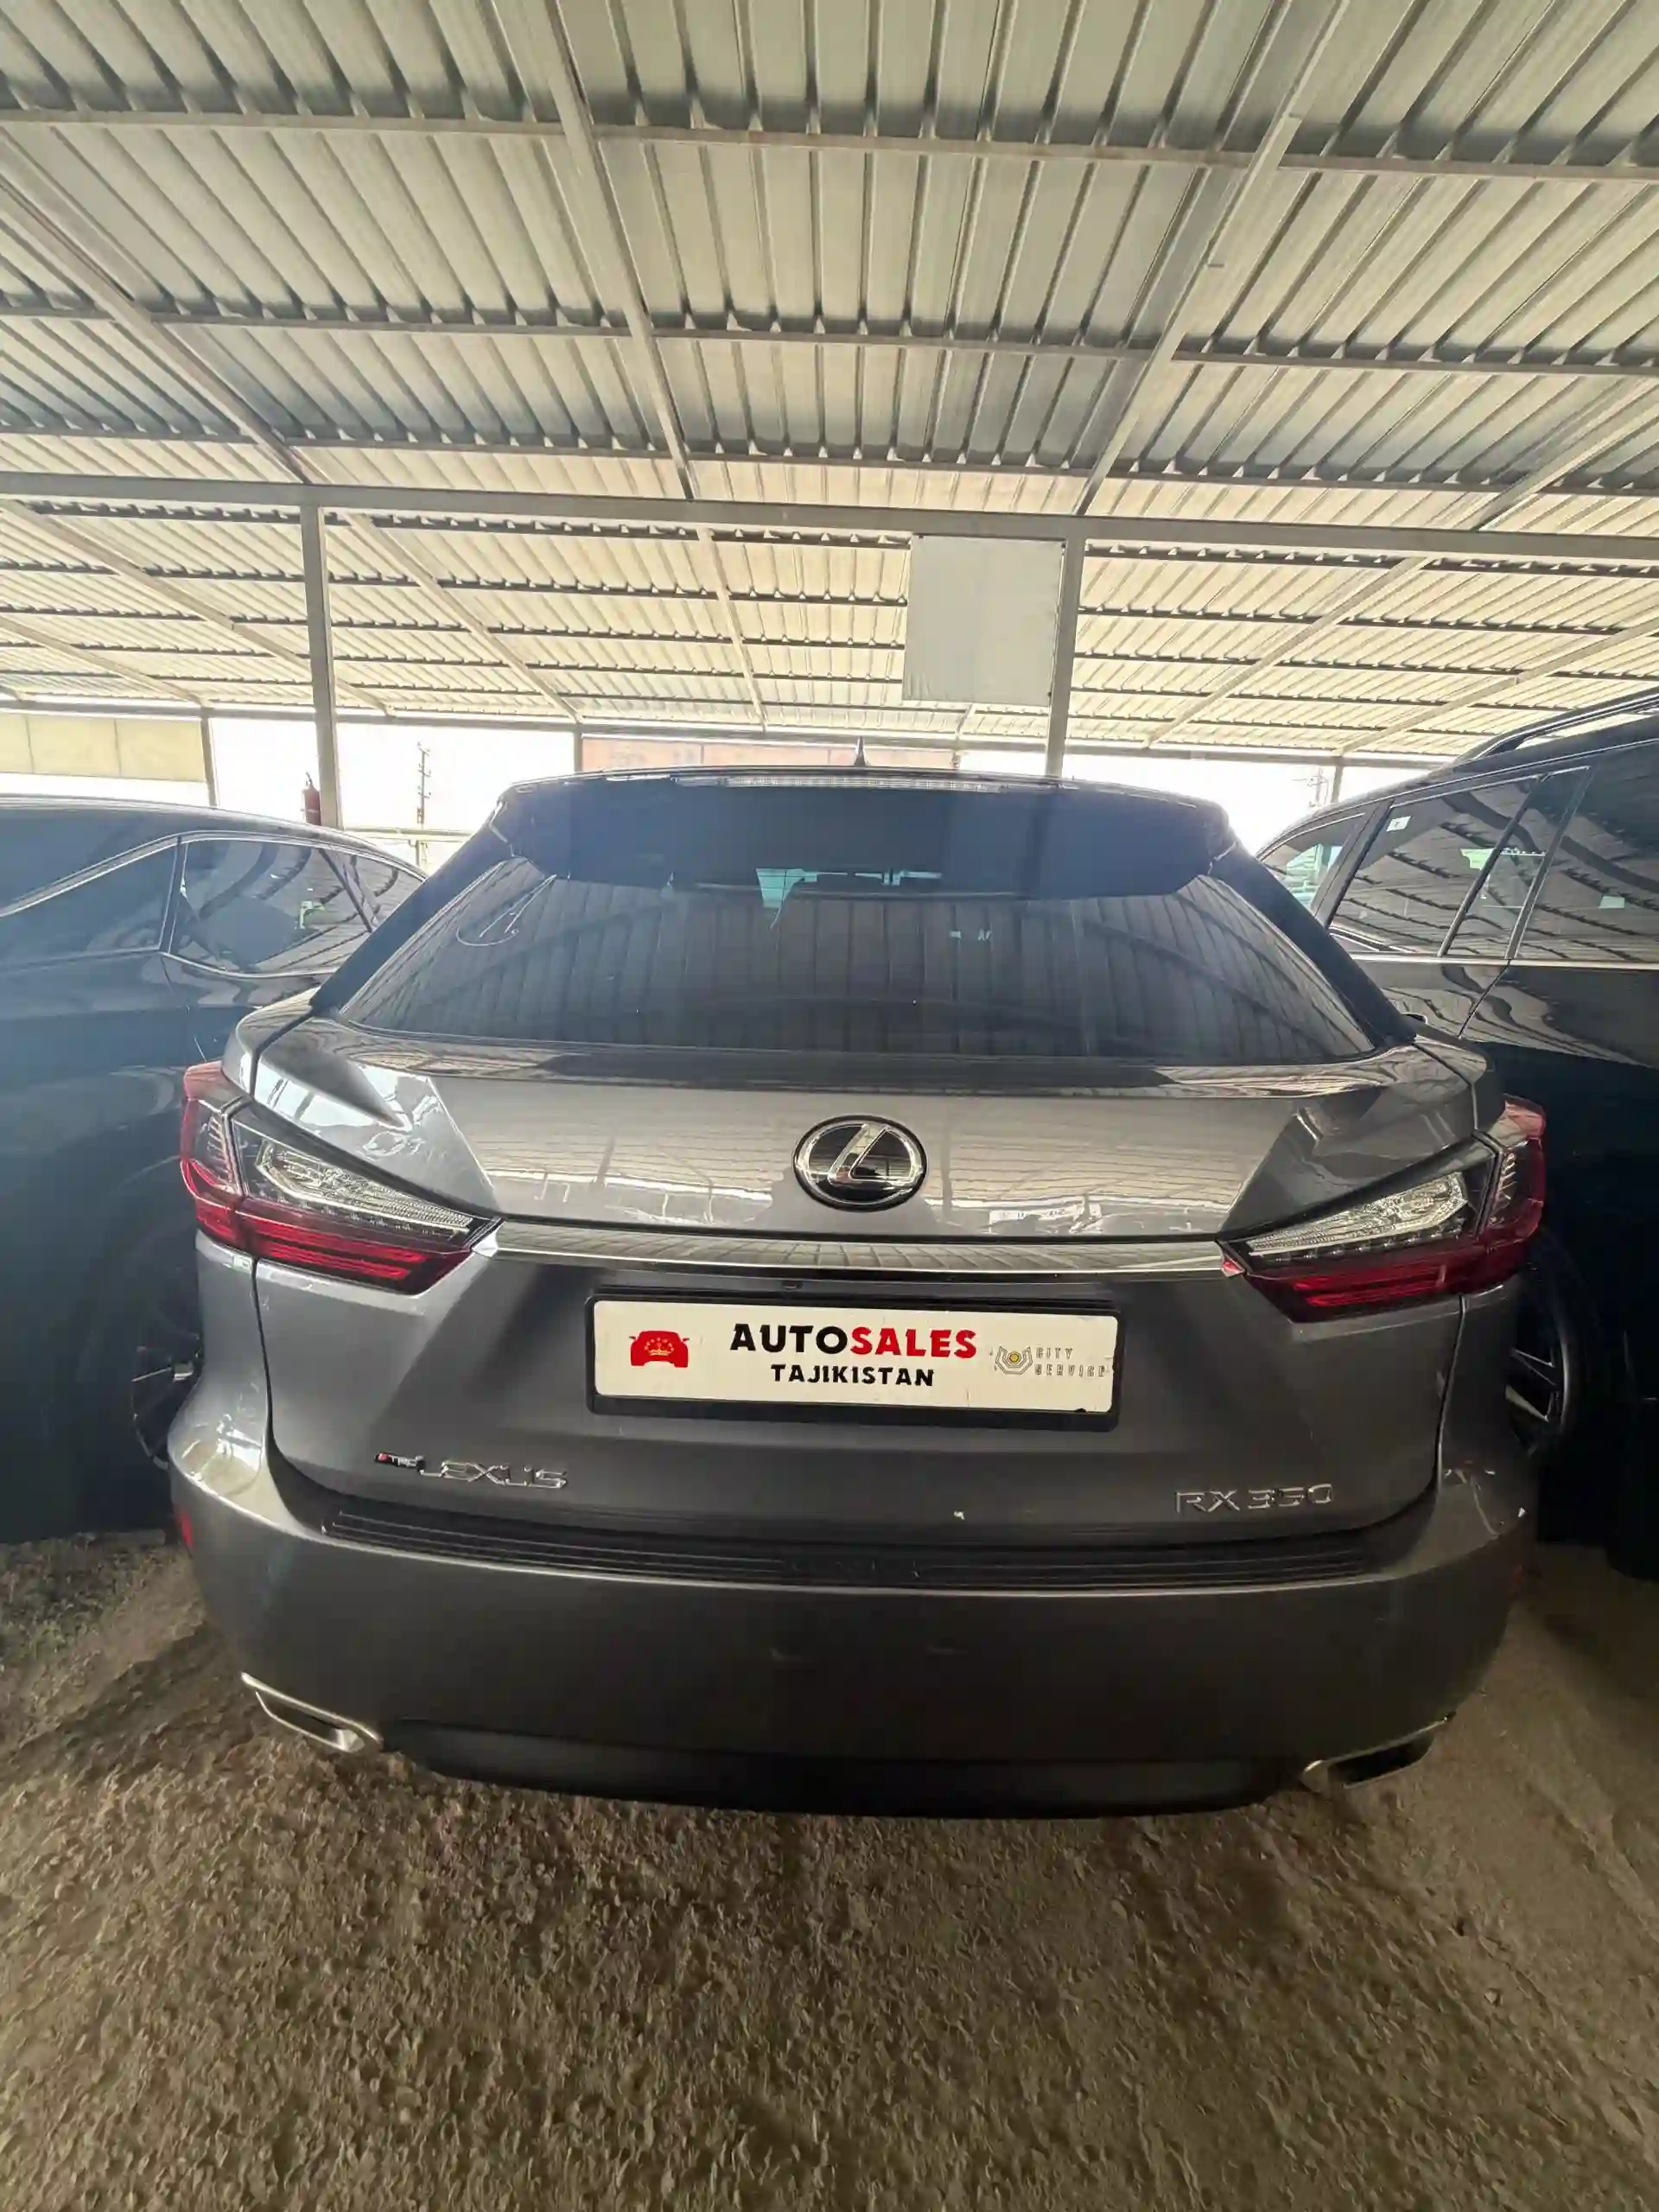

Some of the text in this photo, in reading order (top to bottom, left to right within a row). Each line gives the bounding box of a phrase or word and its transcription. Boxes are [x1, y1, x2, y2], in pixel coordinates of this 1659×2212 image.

[729, 1322, 977, 1359] AUTOSALES
[1035, 1346, 1073, 1359] CITY
[771, 1363, 935, 1387] TAJIKISTAN
[1034, 1363, 1106, 1377] SERVICE
[416, 1456, 567, 1488] LEXUS
[1175, 1484, 1332, 1513] RX 350
